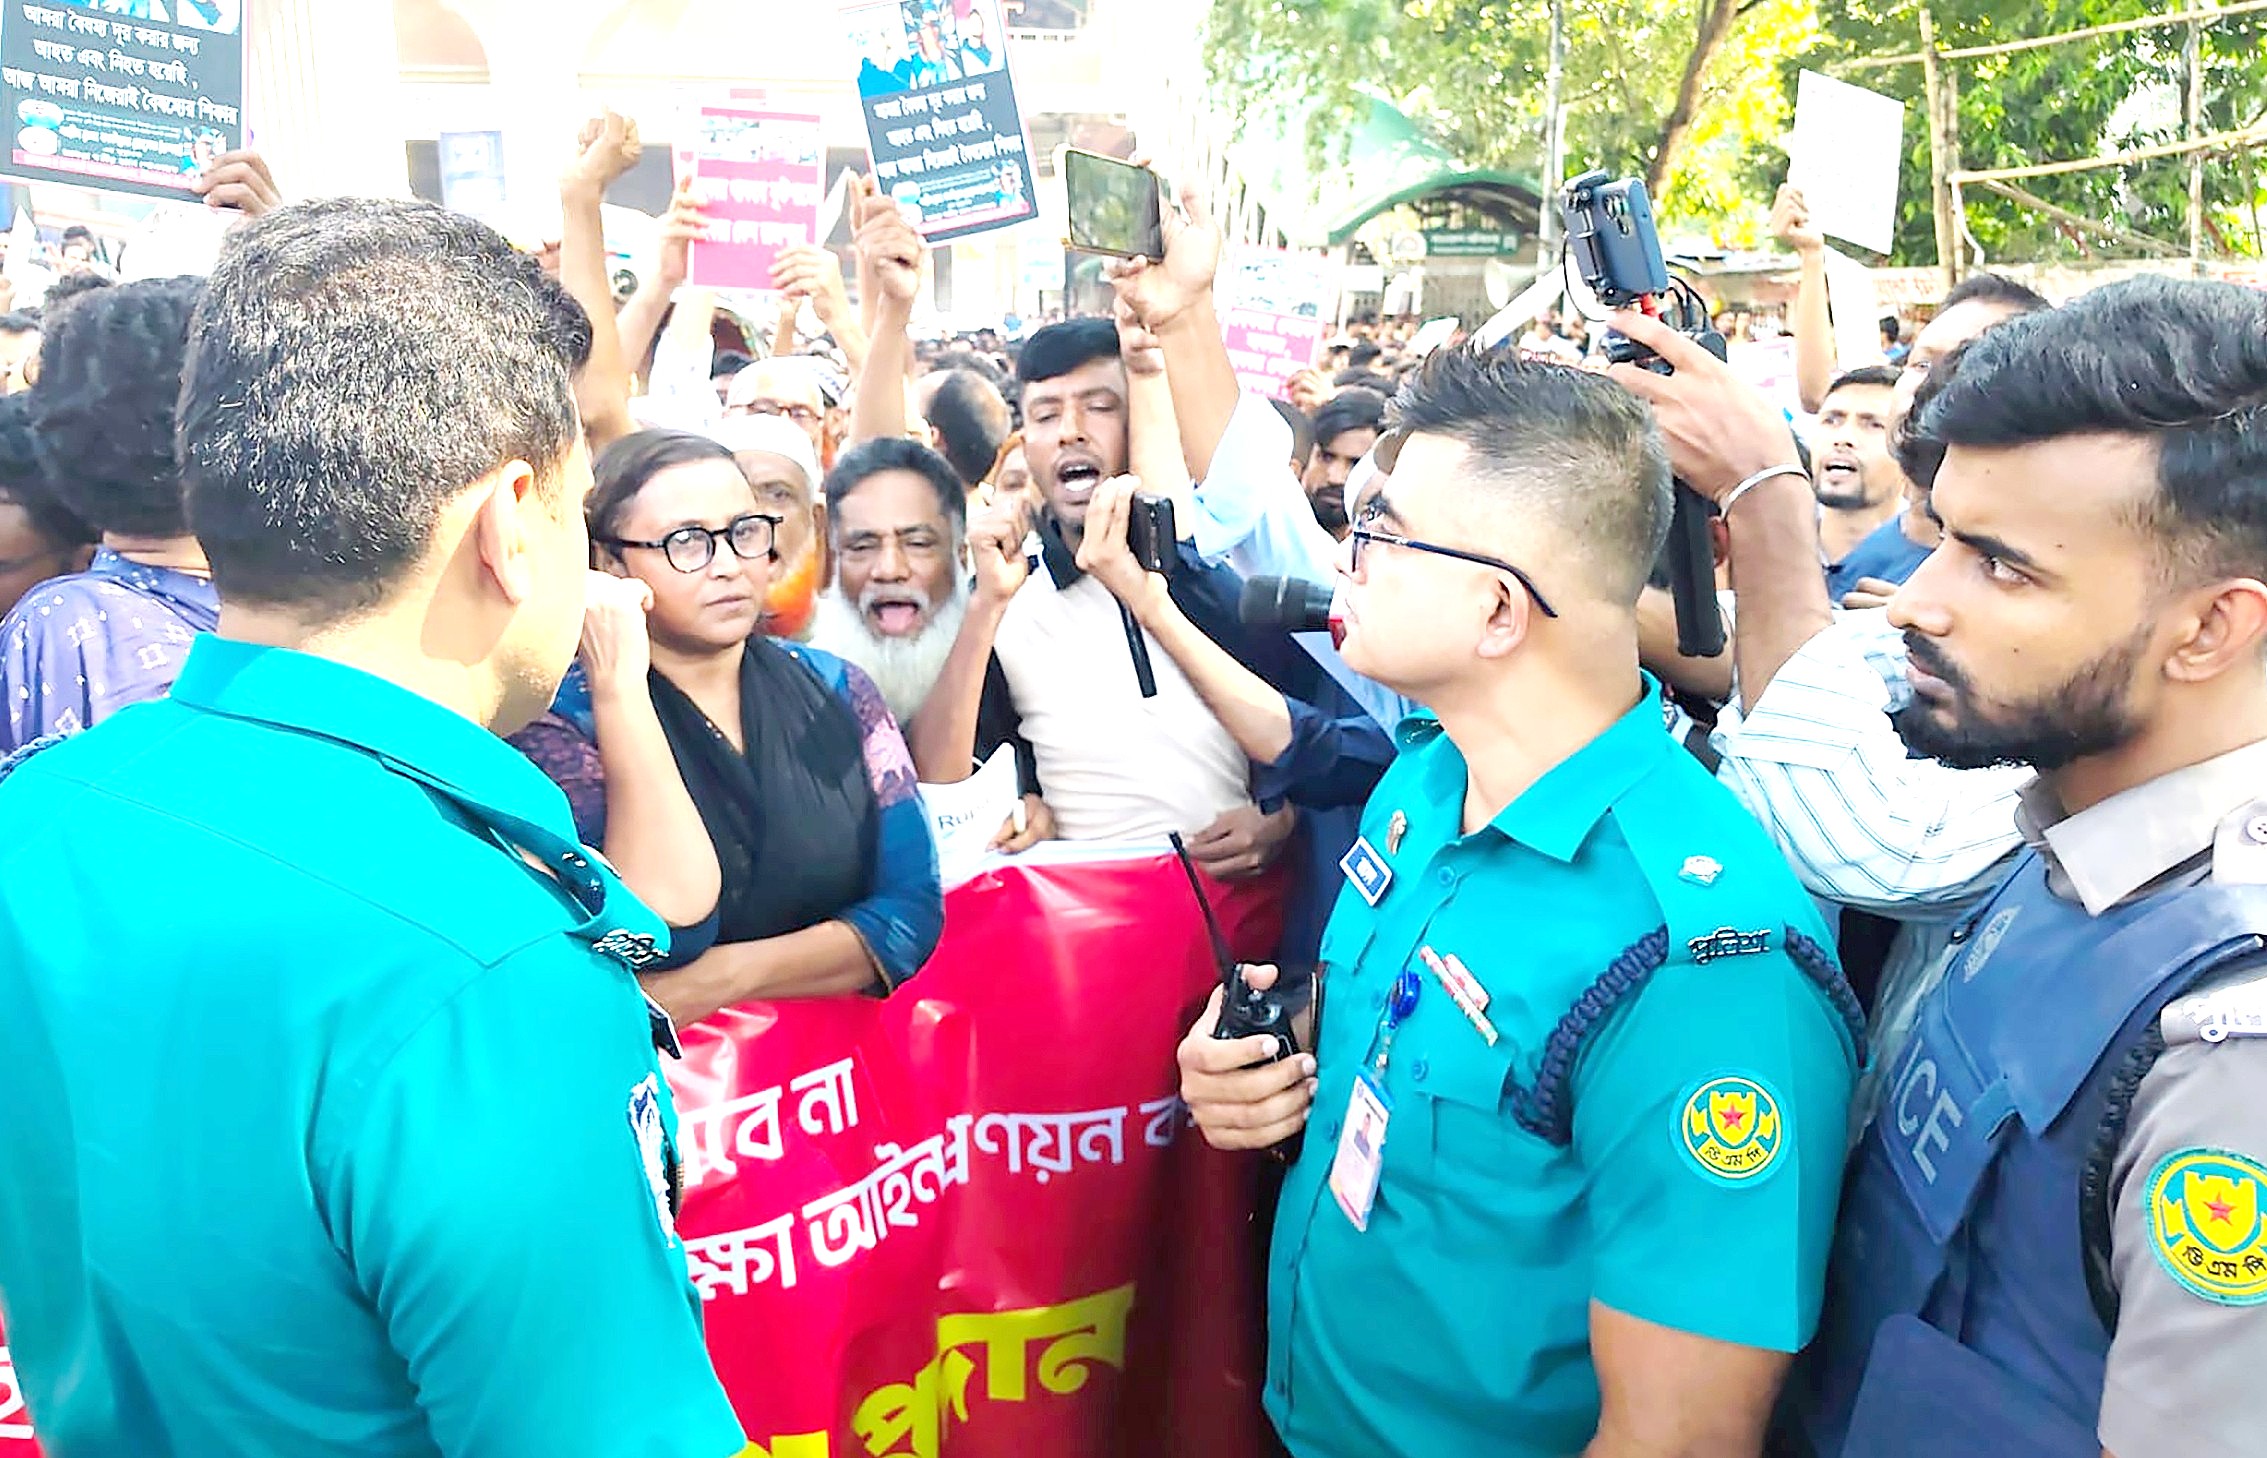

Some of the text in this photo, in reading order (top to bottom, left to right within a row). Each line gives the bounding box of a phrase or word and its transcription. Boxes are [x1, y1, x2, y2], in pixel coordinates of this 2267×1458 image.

[22, 4, 66, 30] আমরা
[111, 22, 132, 48] দূর
[134, 26, 170, 49] করার
[172, 32, 201, 56] জন্য
[33, 39, 76, 64] আহত
[77, 48, 107, 72] এবং
[108, 48, 146, 77] নিহত
[3, 67, 36, 92] আজ
[37, 72, 81, 99] আমরা
[197, 96, 239, 126] শিকার
[790, 1056, 860, 1136] না
[802, 1134, 946, 1268] আইন
